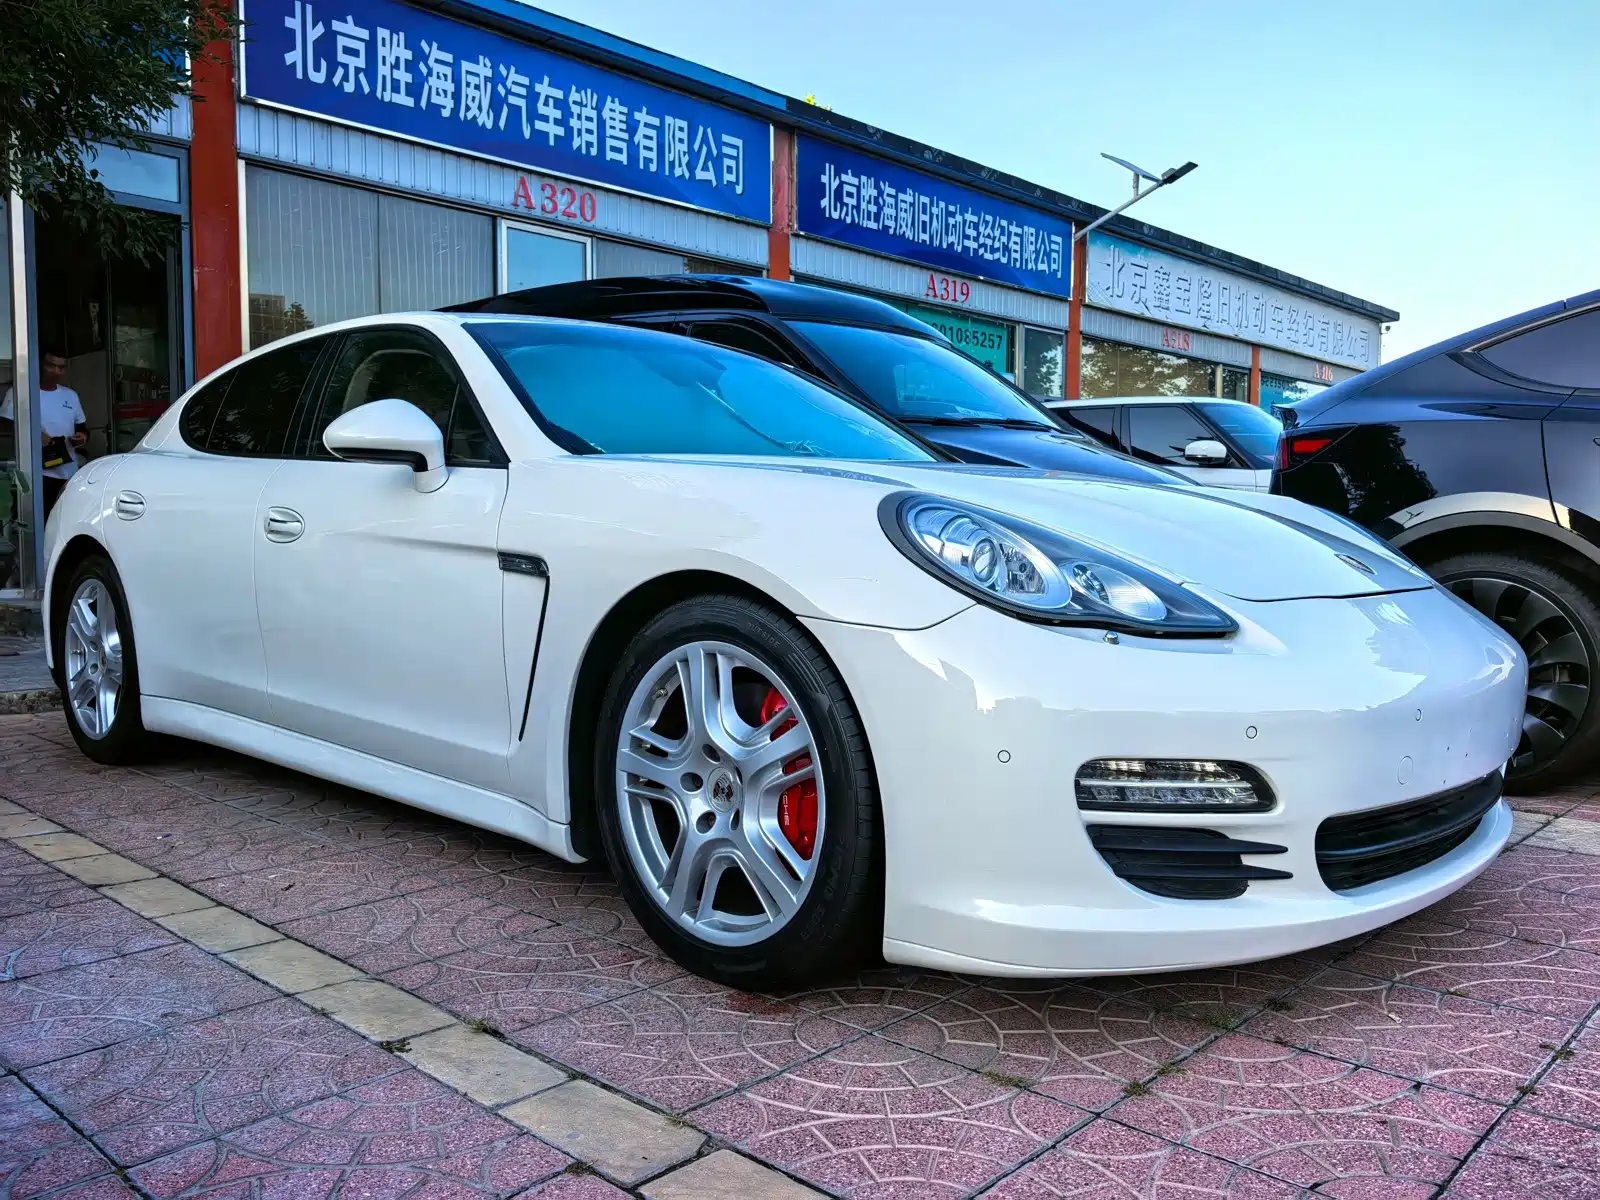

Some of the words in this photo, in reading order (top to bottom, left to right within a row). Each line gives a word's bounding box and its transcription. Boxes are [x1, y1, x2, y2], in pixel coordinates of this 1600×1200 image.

[284, 0, 744, 195] 北京胜海威汽车销售有限公司
[511, 176, 597, 223] A320
[820, 162, 1063, 279] 北京胜海威旧机动车经纪有限公司
[925, 273, 971, 303] A319
